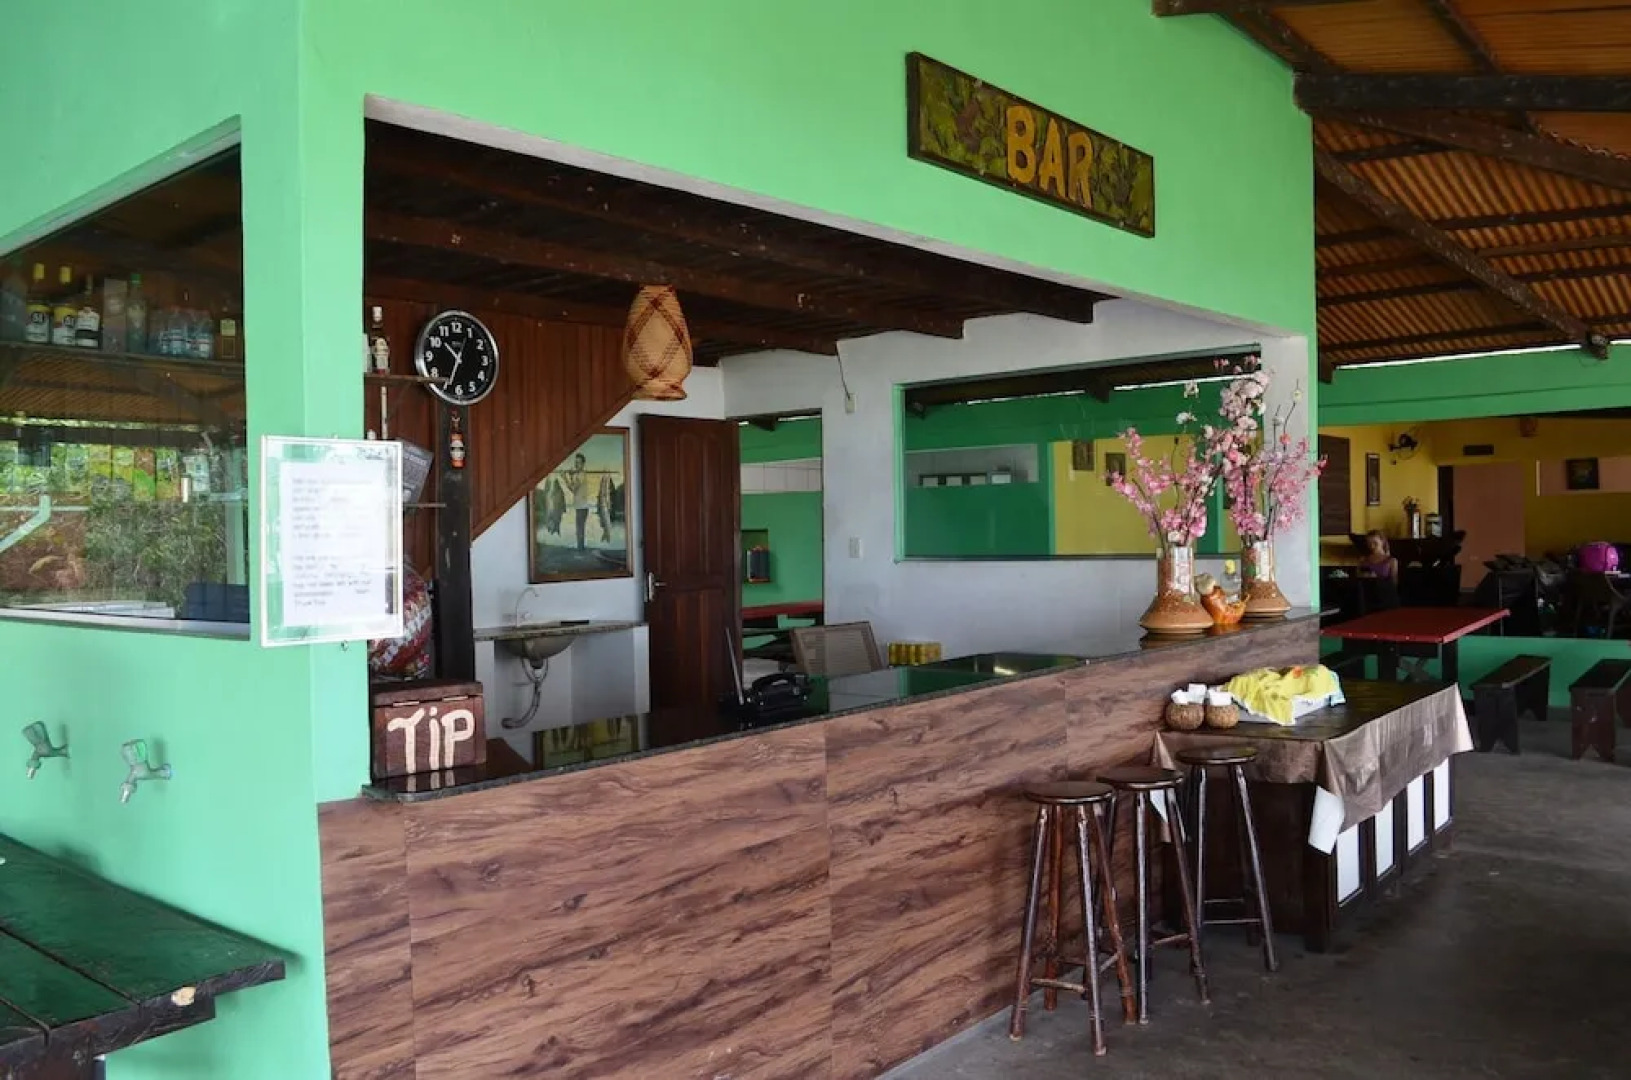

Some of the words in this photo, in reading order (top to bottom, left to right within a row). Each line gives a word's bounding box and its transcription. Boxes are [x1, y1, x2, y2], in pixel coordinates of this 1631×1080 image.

[1005, 104, 1094, 209] BAR
[439, 326, 449, 336] 11
[450, 322, 463, 333] 12
[466, 328, 473, 338] 1
[429, 336, 442, 348] 10
[476, 339, 483, 350] 2
[425, 351, 433, 361] 9
[481, 355, 489, 366] 3
[430, 367, 438, 378] 8
[477, 370, 485, 381] 4
[455, 385, 463, 395] 6
[469, 381, 476, 392] 5
